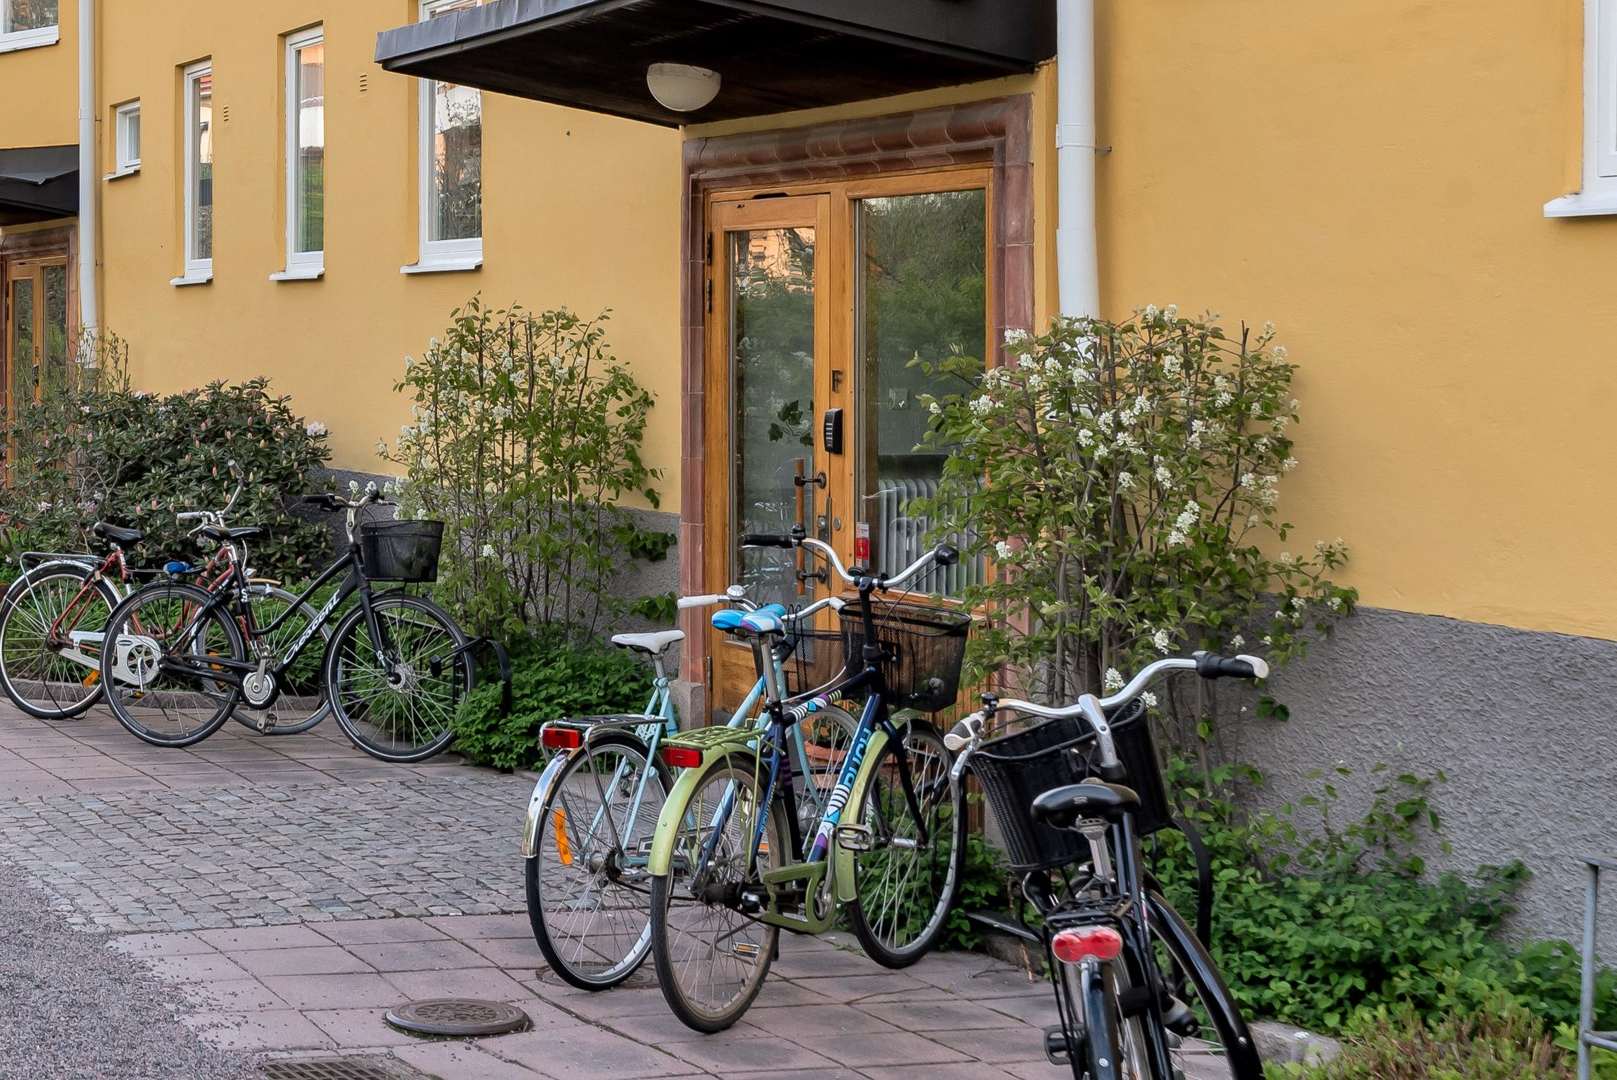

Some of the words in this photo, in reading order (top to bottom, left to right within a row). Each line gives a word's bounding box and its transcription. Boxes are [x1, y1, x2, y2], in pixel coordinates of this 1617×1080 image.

[832, 369, 843, 392] F
[283, 589, 340, 665] Crescent
[843, 727, 872, 790] PUCH
